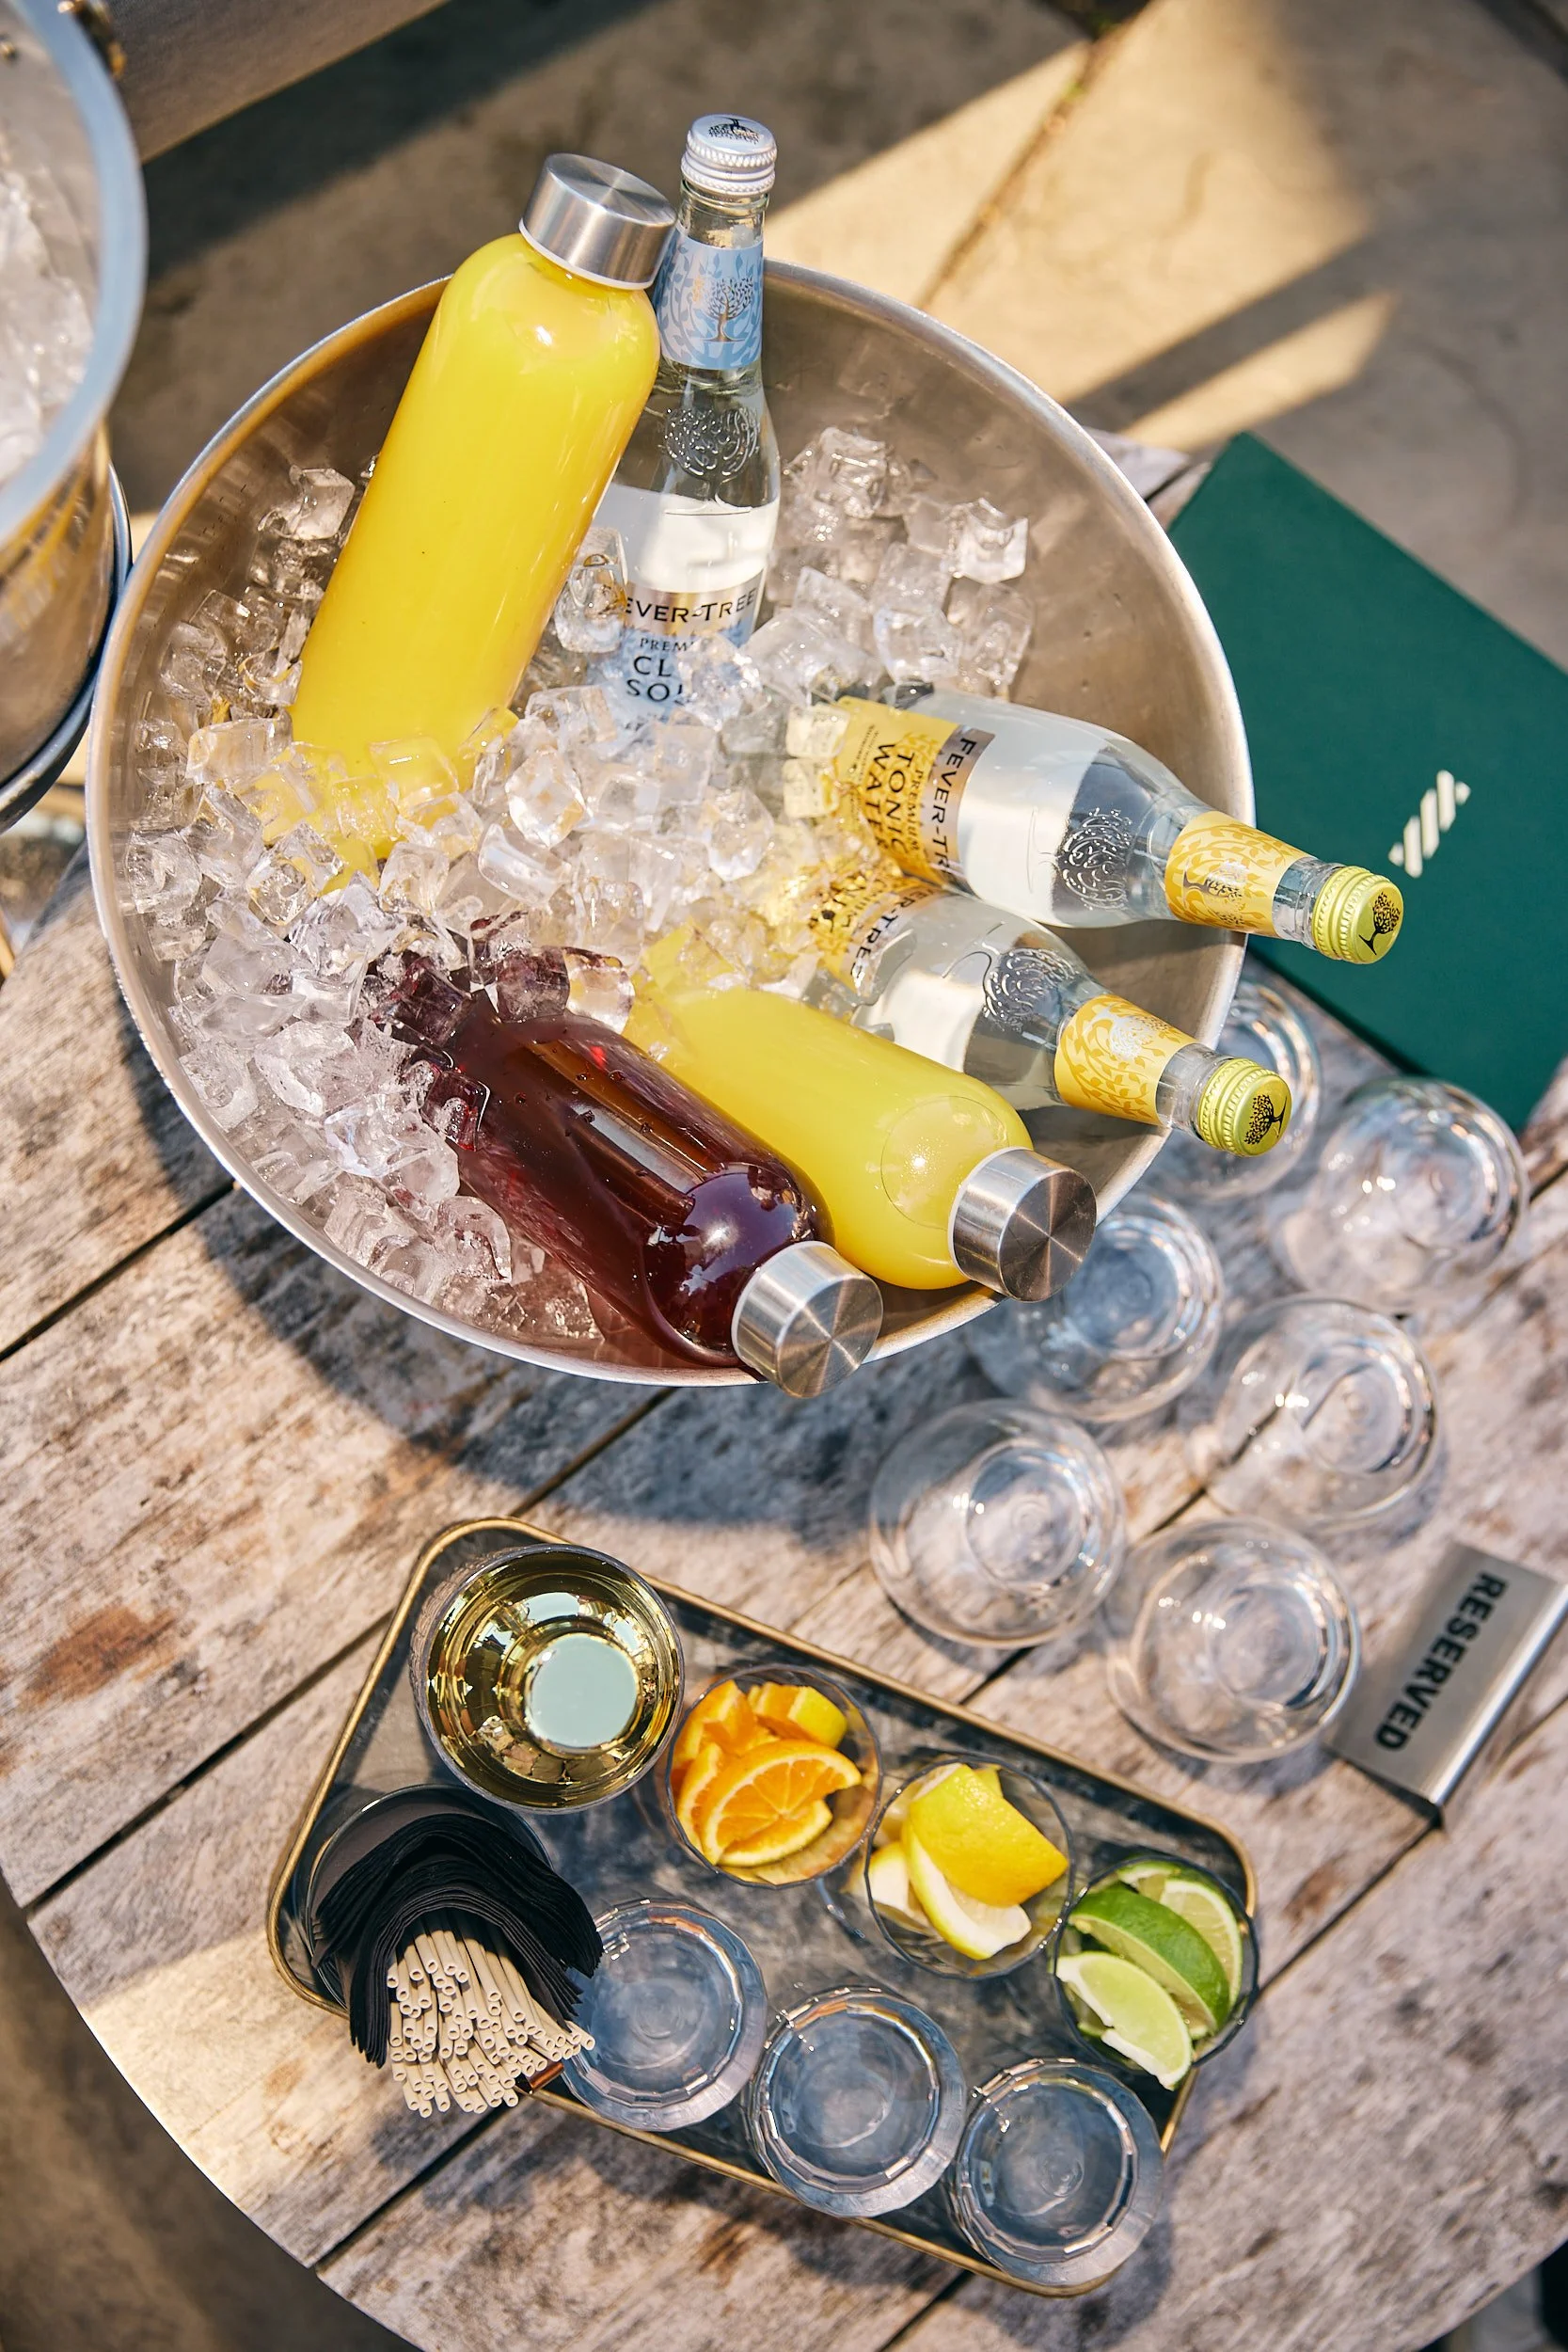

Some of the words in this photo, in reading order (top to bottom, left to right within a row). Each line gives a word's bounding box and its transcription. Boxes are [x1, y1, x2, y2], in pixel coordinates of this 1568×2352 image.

[625, 587, 757, 623] EVER-TREE
[633, 655, 673, 677] CL
[640, 637, 692, 652] PREM
[886, 753, 915, 853] TONIC
[931, 738, 977, 870] FEVER-TR
[1374, 1571, 1510, 1753] RESERVED
